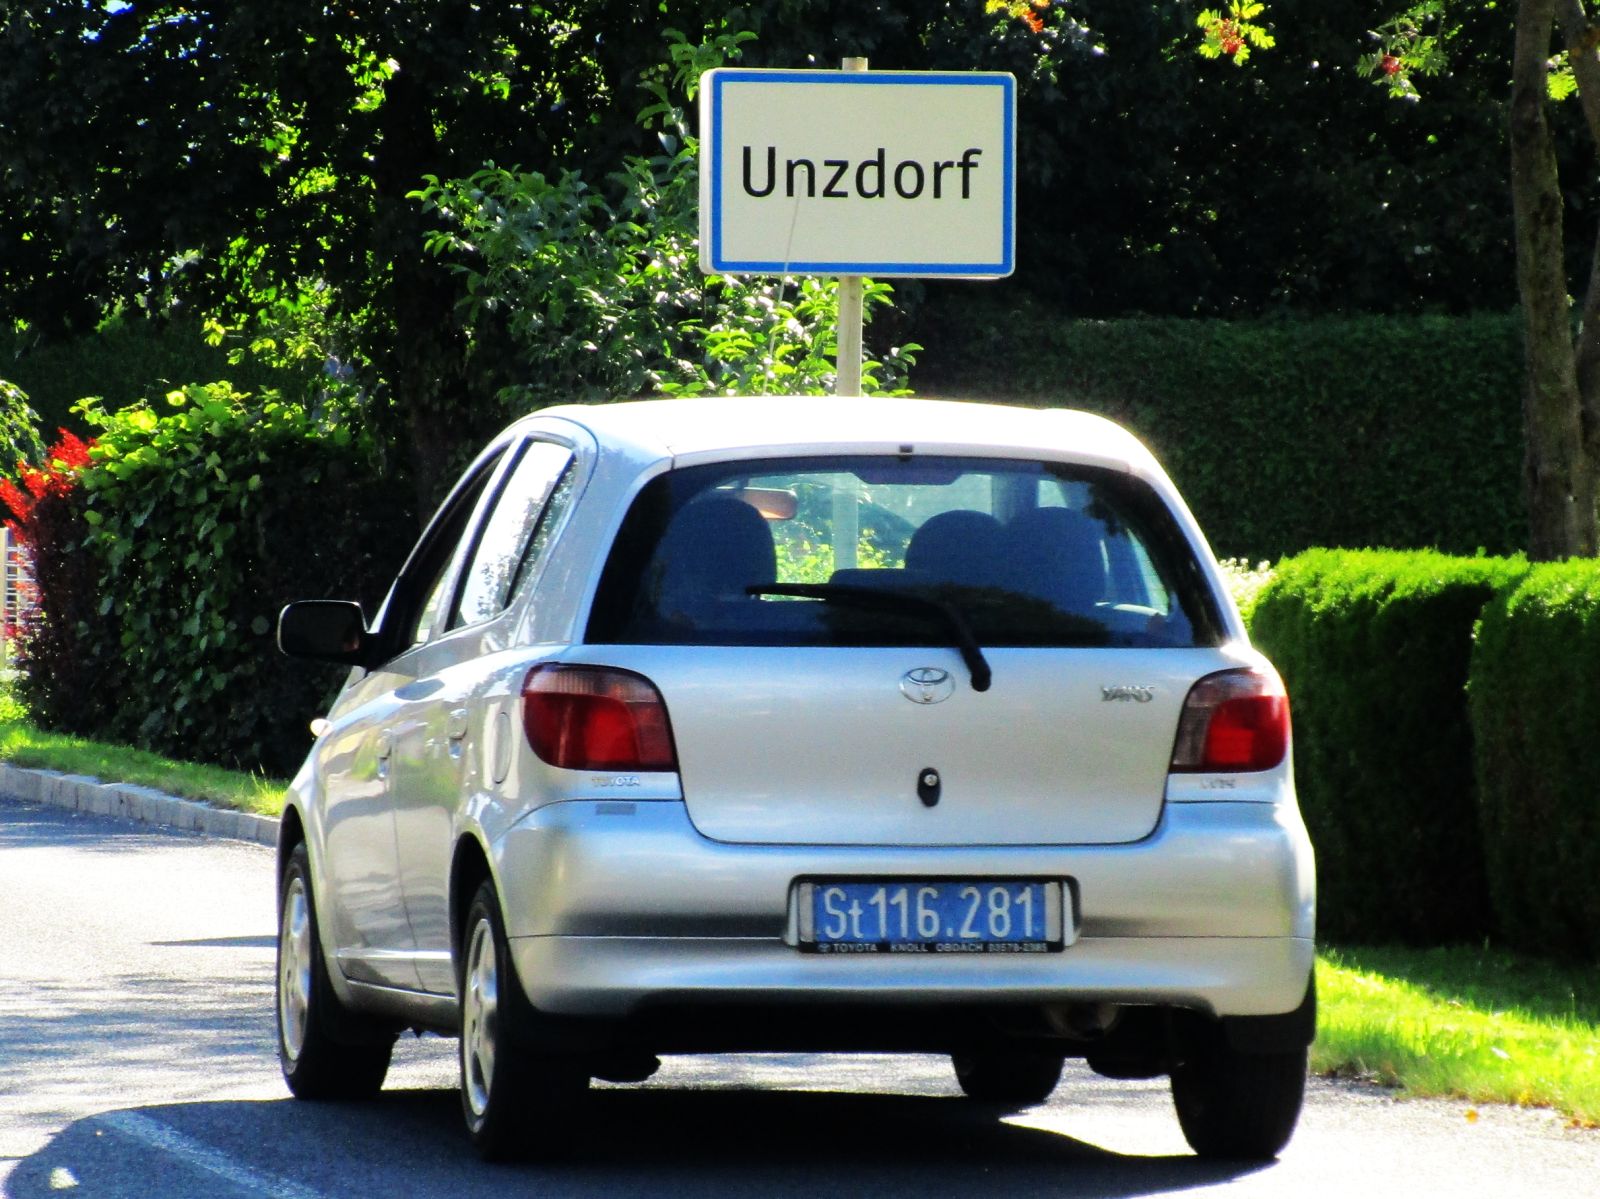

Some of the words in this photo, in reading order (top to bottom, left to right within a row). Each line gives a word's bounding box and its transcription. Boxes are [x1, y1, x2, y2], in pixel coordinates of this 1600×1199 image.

[742, 145, 983, 200] Unzdorf
[833, 943, 878, 953] TOYOTA
[890, 943, 928, 953] KNOLL
